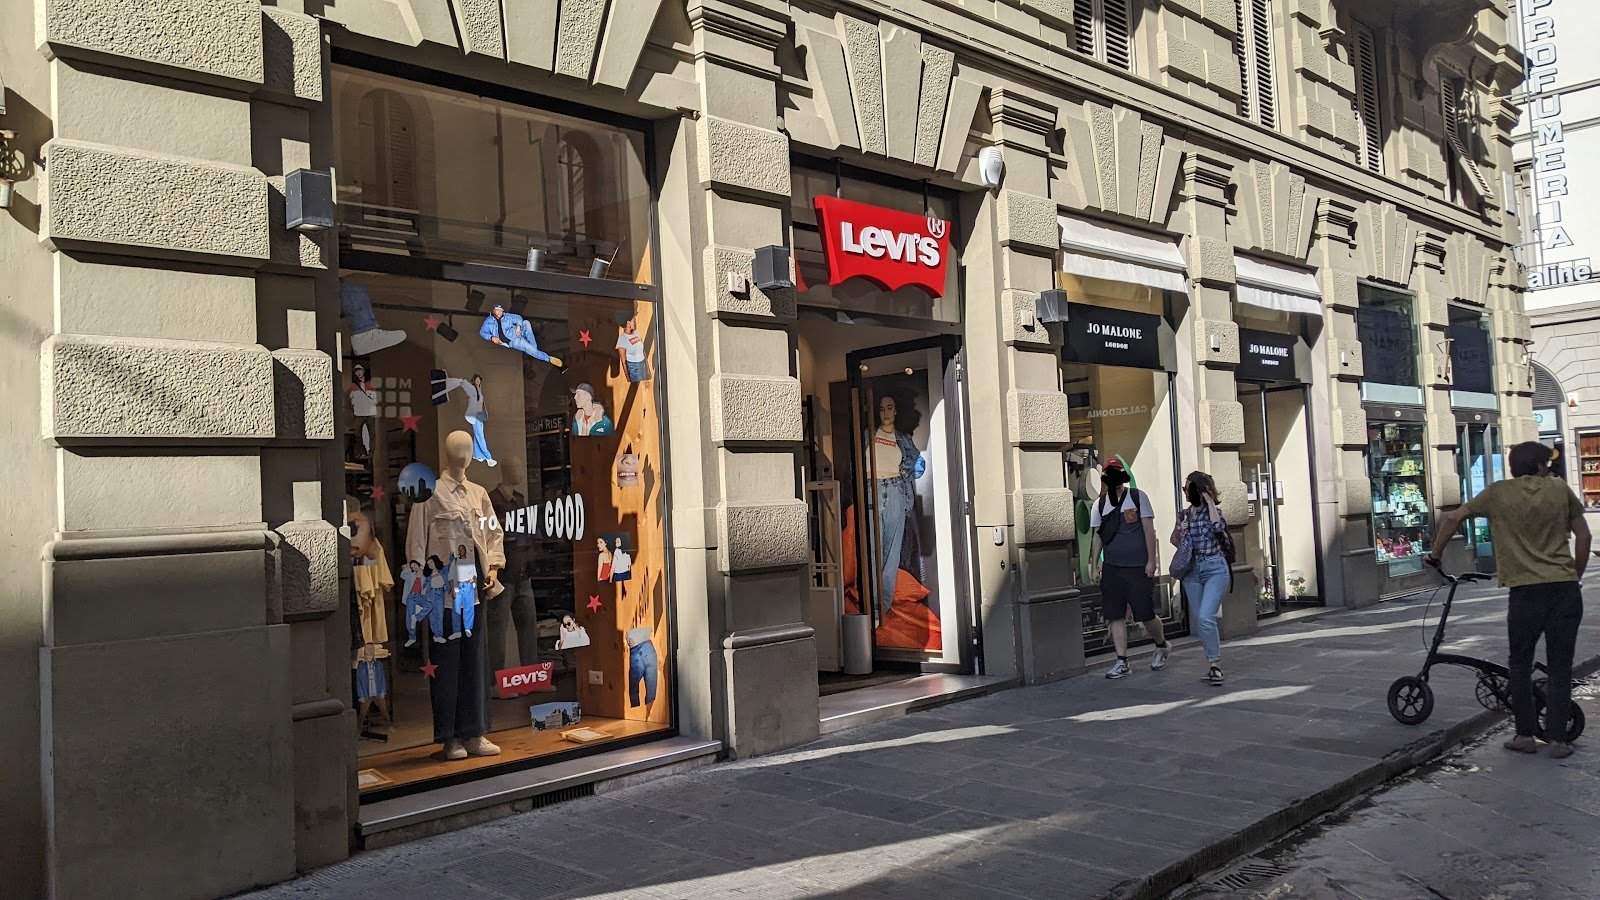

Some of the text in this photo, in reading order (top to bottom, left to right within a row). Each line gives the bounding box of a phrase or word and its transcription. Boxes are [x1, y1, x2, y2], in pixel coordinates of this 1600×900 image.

[1527, 0, 1575, 250] PROFUMERIA
[1528, 265, 1592, 288] aline
[1087, 322, 1142, 340] JO MALONE
[1105, 341, 1129, 350] LONDON
[1249, 344, 1289, 357] JO MALONE
[478, 492, 584, 540] TO NEW GOOD
